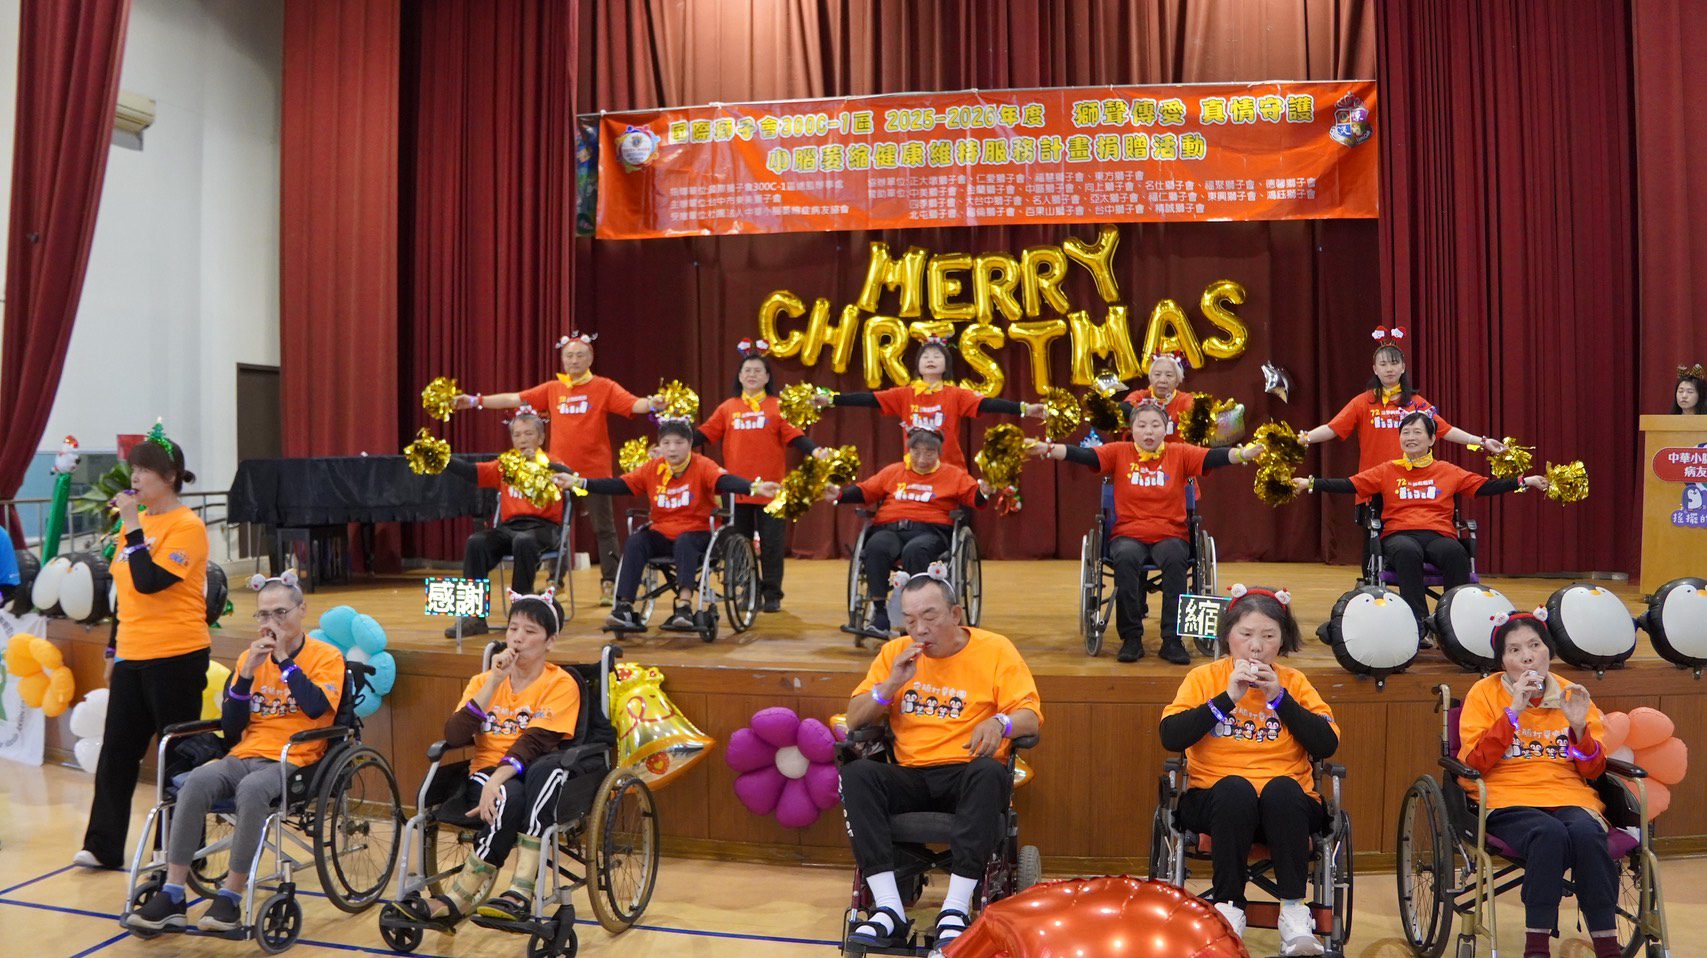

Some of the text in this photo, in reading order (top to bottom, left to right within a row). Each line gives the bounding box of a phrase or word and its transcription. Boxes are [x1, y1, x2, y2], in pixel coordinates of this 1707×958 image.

[668, 94, 1316, 146] 國際獅子會300C-1區 2025-2026年度 獅聲傳愛 真情守護
[766, 132, 1208, 175] 小腦萎縮健康維持服務計畫捐贈活動
[859, 223, 1121, 319] MERRY
[427, 581, 486, 616] 感謝
[1178, 598, 1221, 637] 縮
